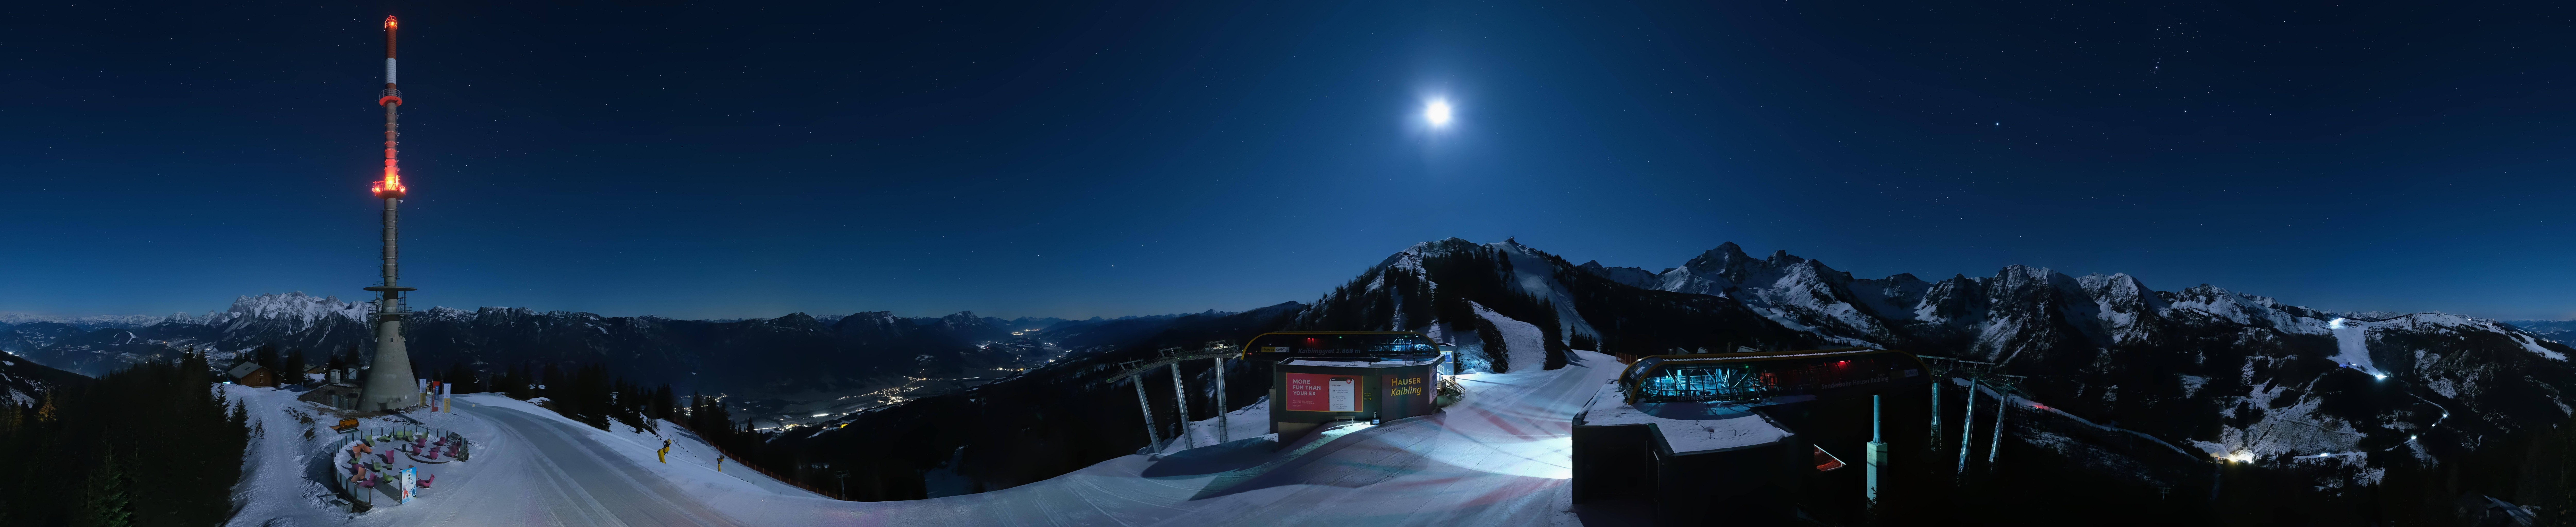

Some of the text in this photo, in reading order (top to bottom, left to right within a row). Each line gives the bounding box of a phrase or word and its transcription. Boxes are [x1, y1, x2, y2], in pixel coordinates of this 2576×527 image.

[1391, 378, 1421, 386] HAUSER
[1821, 380, 1852, 389] Senderbahn
[1391, 386, 1421, 396] Kaibling
